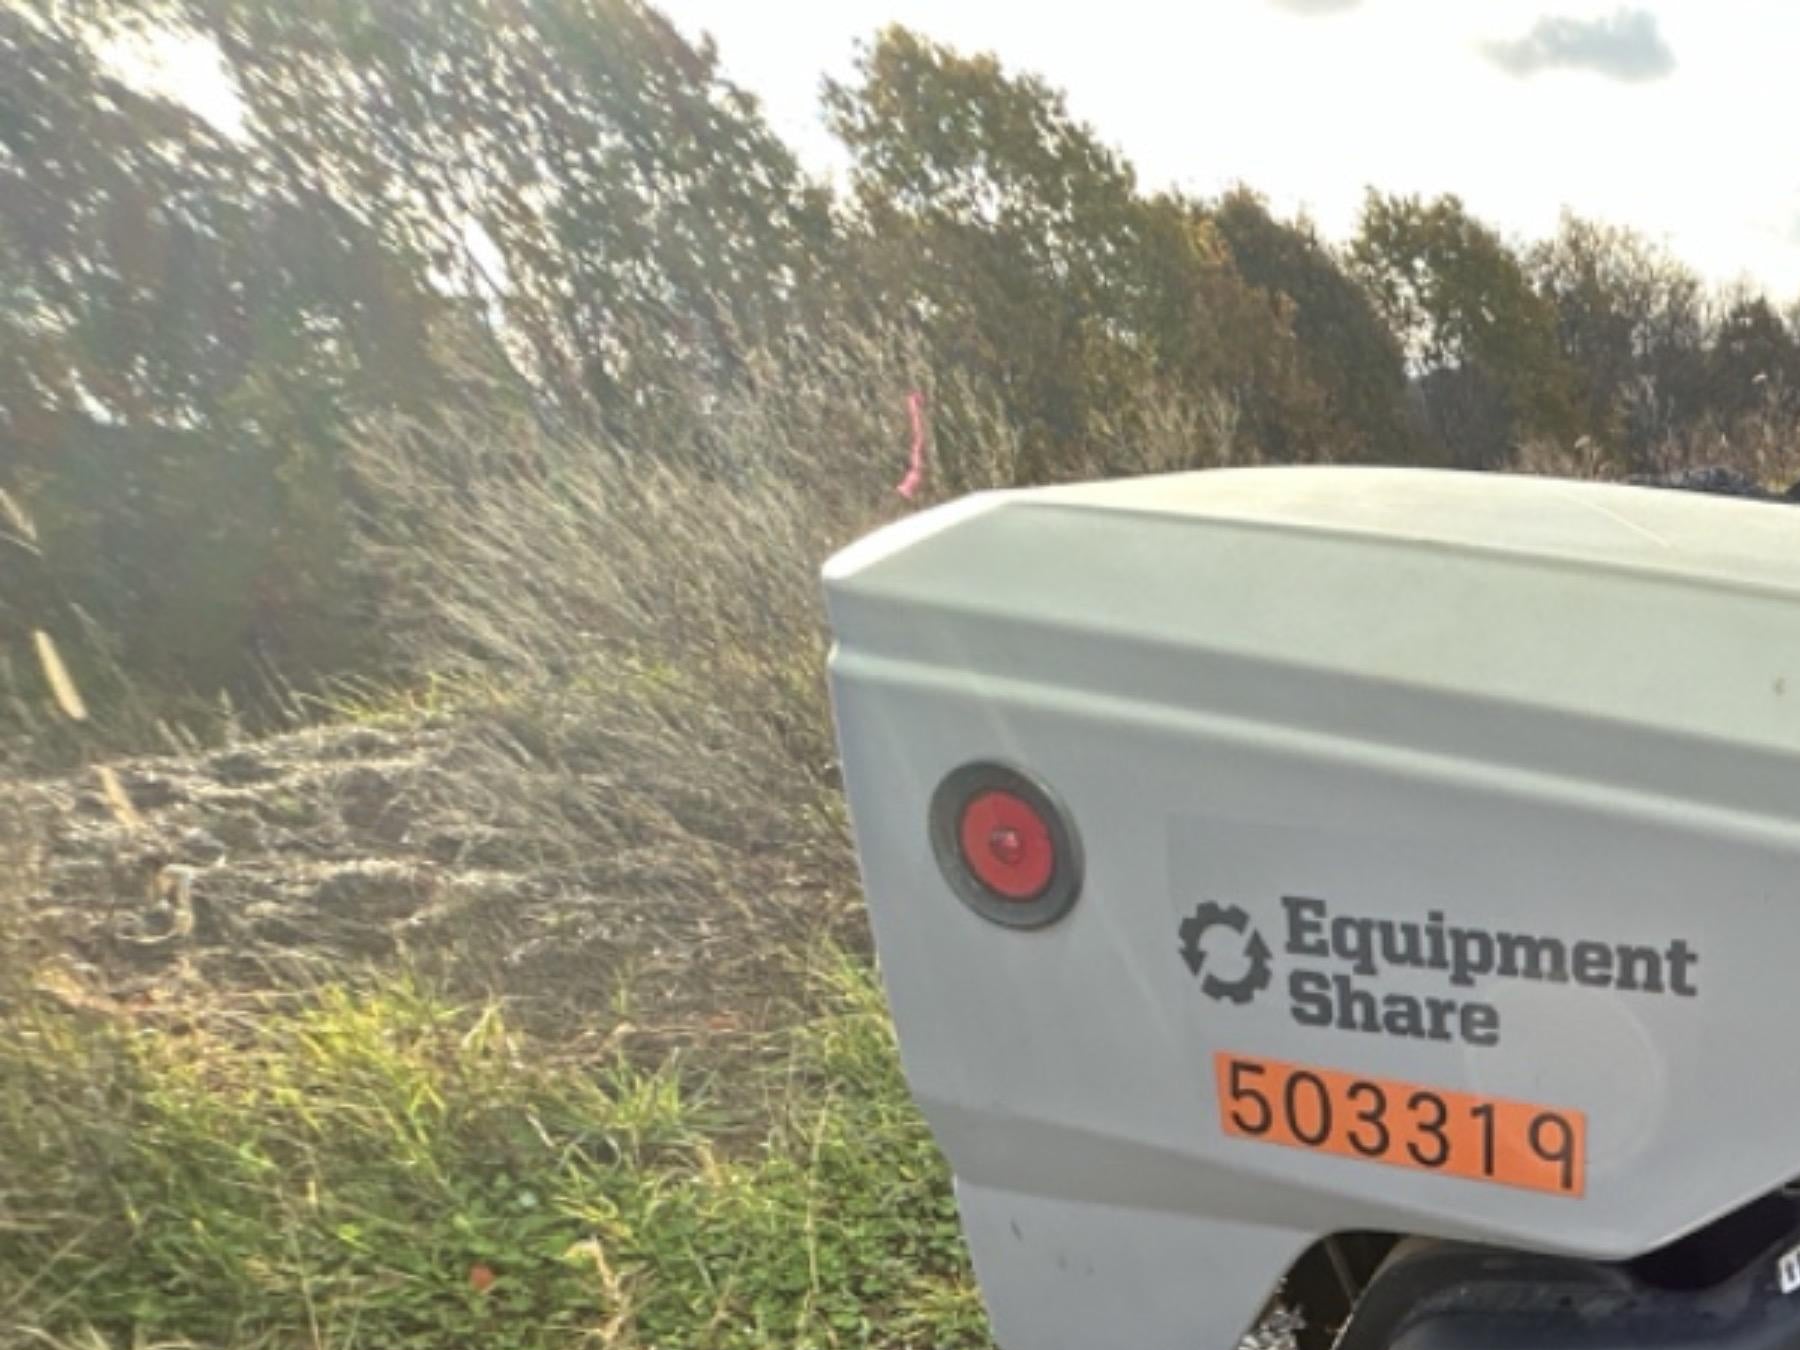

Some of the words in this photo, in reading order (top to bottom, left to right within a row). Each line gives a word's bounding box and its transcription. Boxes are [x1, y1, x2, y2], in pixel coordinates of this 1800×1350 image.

[1280, 896, 1698, 998] Equipment
[1288, 968, 1500, 1047] Share
[1229, 1060, 1575, 1190] 503319
